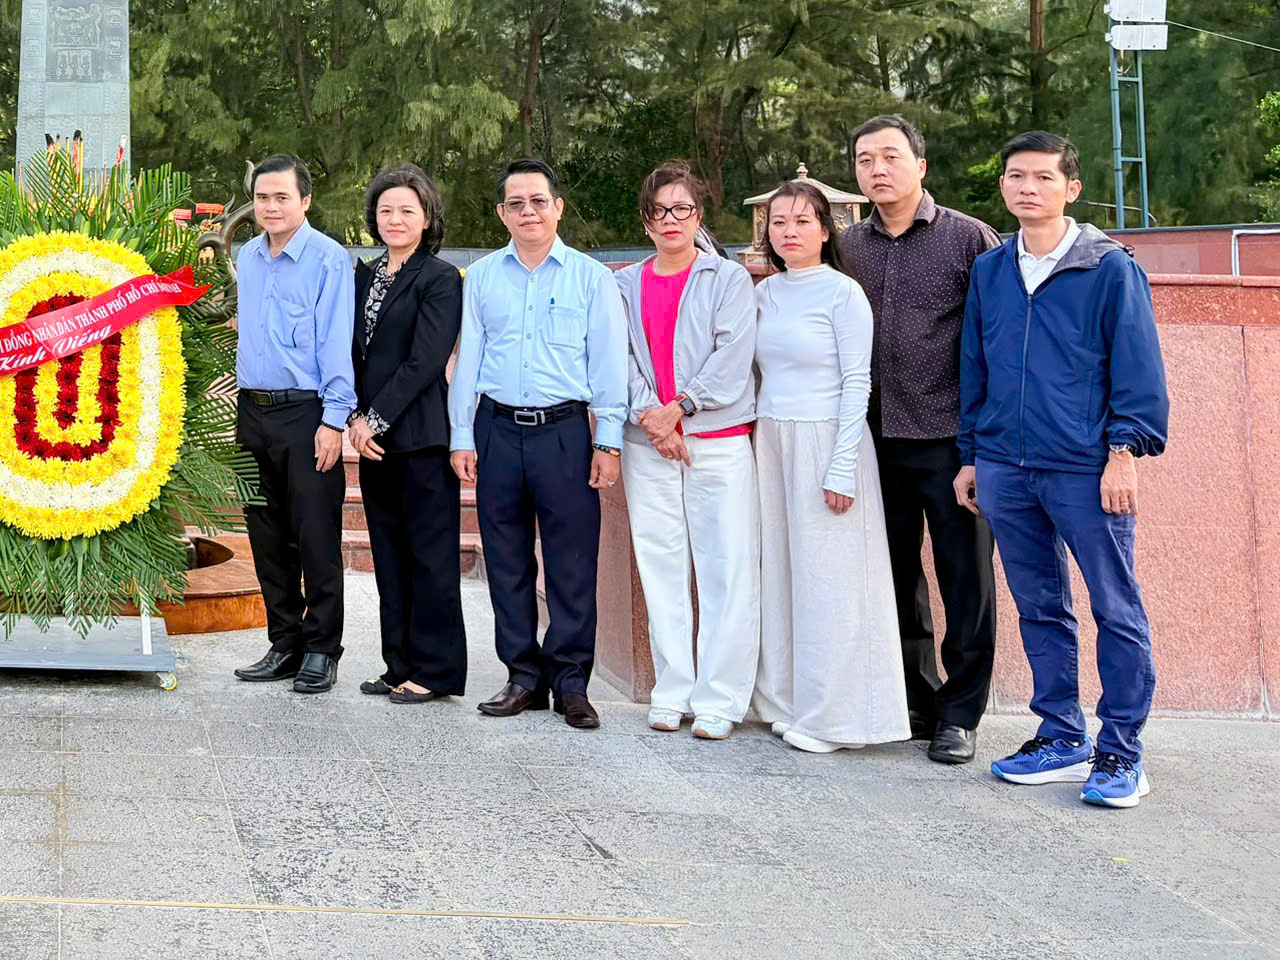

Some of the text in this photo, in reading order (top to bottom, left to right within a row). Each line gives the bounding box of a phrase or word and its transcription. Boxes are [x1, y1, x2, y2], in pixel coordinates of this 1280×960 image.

[4, 329, 32, 351] ĐỒNG
[56, 316, 77, 335] DÂN
[75, 308, 109, 328] THÀNH
[106, 290, 127, 315] PHỐ
[125, 283, 141, 304] HỒ
[140, 280, 159, 296] CHÍ
[52, 324, 112, 354] Viếng
